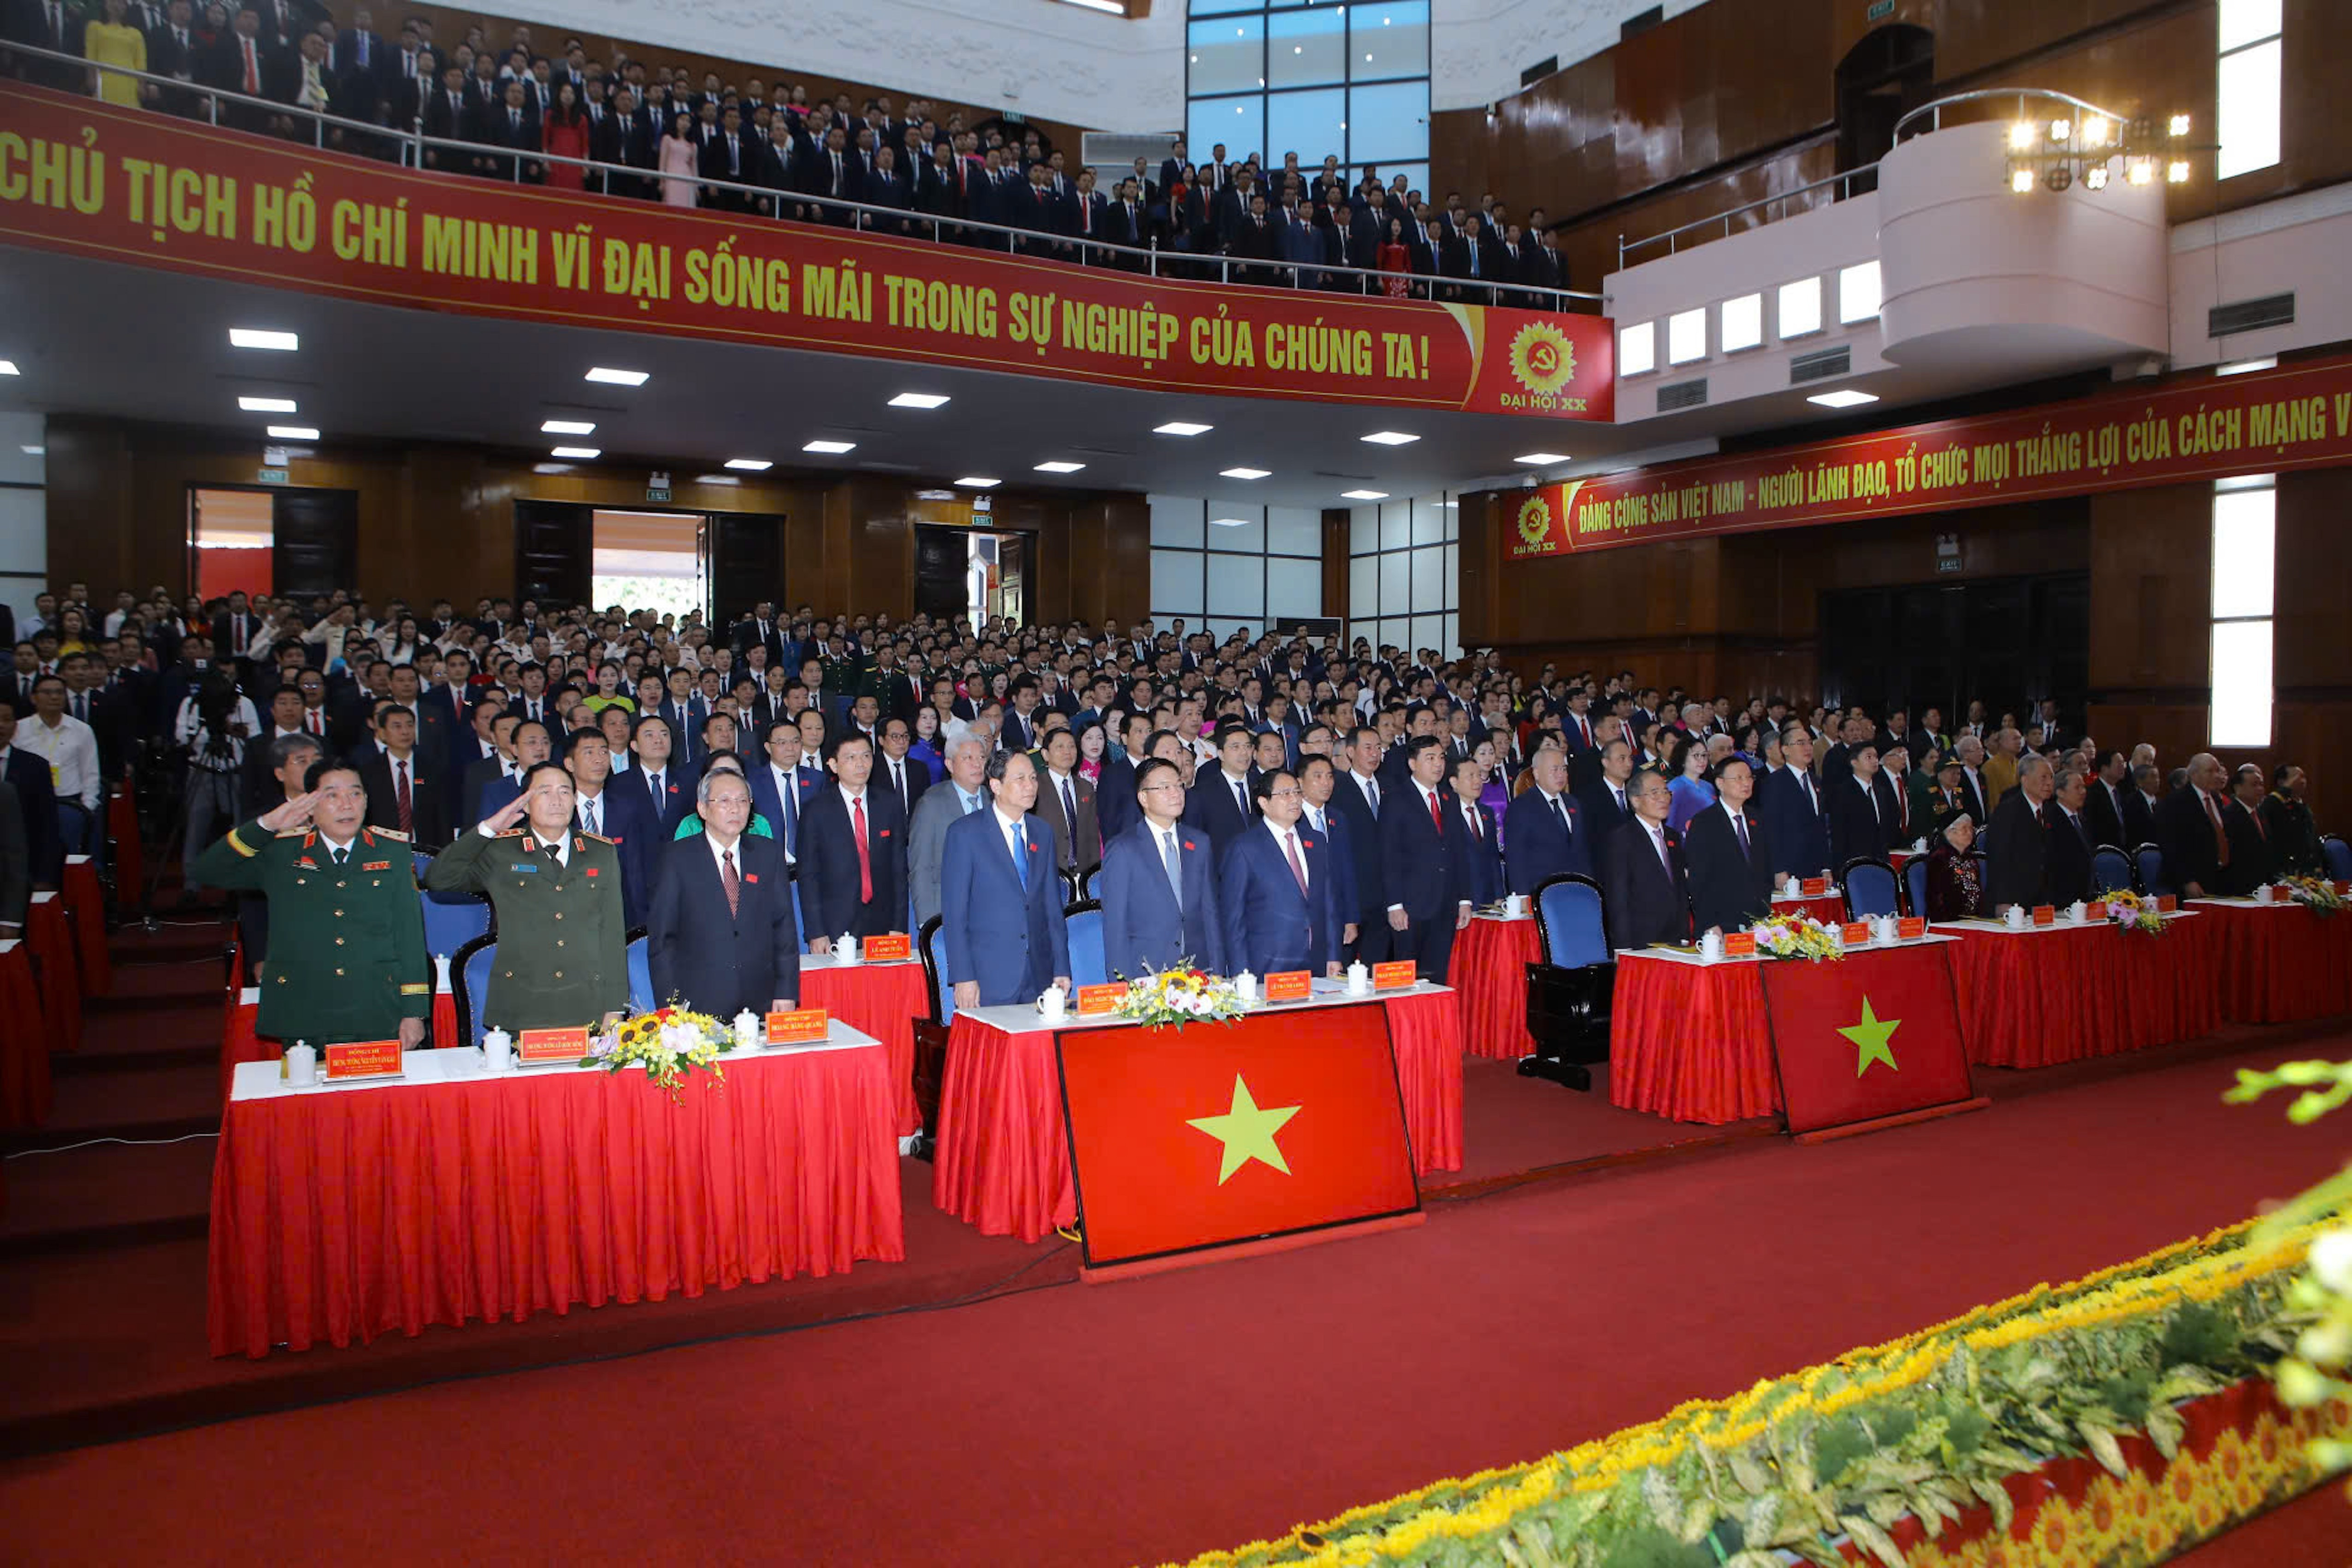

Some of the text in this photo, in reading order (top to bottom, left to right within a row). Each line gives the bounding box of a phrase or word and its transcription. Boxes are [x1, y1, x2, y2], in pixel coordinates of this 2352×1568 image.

[0, 126, 105, 214] CHỦ
[123, 157, 237, 242] TỊCH
[254, 171, 316, 253] HỒ
[332, 197, 408, 268] CHÍ
[422, 214, 538, 284] MINH
[551, 224, 593, 290] VĨ
[603, 238, 671, 310] ĐẠI
[685, 235, 790, 313] SỐNG
[803, 259, 872, 323] MÃI
[884, 275, 997, 338] TRONG
[1009, 292, 1056, 356] SỰ
[1063, 301, 1179, 370] NGHIỆP
[1190, 303, 1255, 367] CỦA
[1266, 318, 1372, 376] CHÚNG
[1500, 392, 1587, 413] ĐẠI HỘI XX
[1579, 493, 1612, 534] ĐẢNG
[1614, 493, 1648, 533] CỘNG
[1650, 481, 1678, 524] SẢN
[1681, 480, 1708, 525] VIỆT
[1712, 481, 1745, 515] NAM
[1758, 465, 1804, 509] NGƯỜI
[1808, 463, 1849, 504] LÃNH
[1853, 460, 1890, 504] ĐẠO,
[1895, 442, 1917, 492] TỔ
[1921, 443, 1968, 489] CHỨC
[1974, 442, 2009, 489] MỌI
[2015, 421, 2081, 477] THẮNG
[2087, 422, 2119, 475] LỢI
[2127, 407, 2171, 463] CỦA
[2178, 403, 2241, 456] CÁCH
[2249, 397, 2326, 454] MẠNG
[1513, 546, 1526, 556] ĐẠI
[1542, 542, 1556, 551] XX
